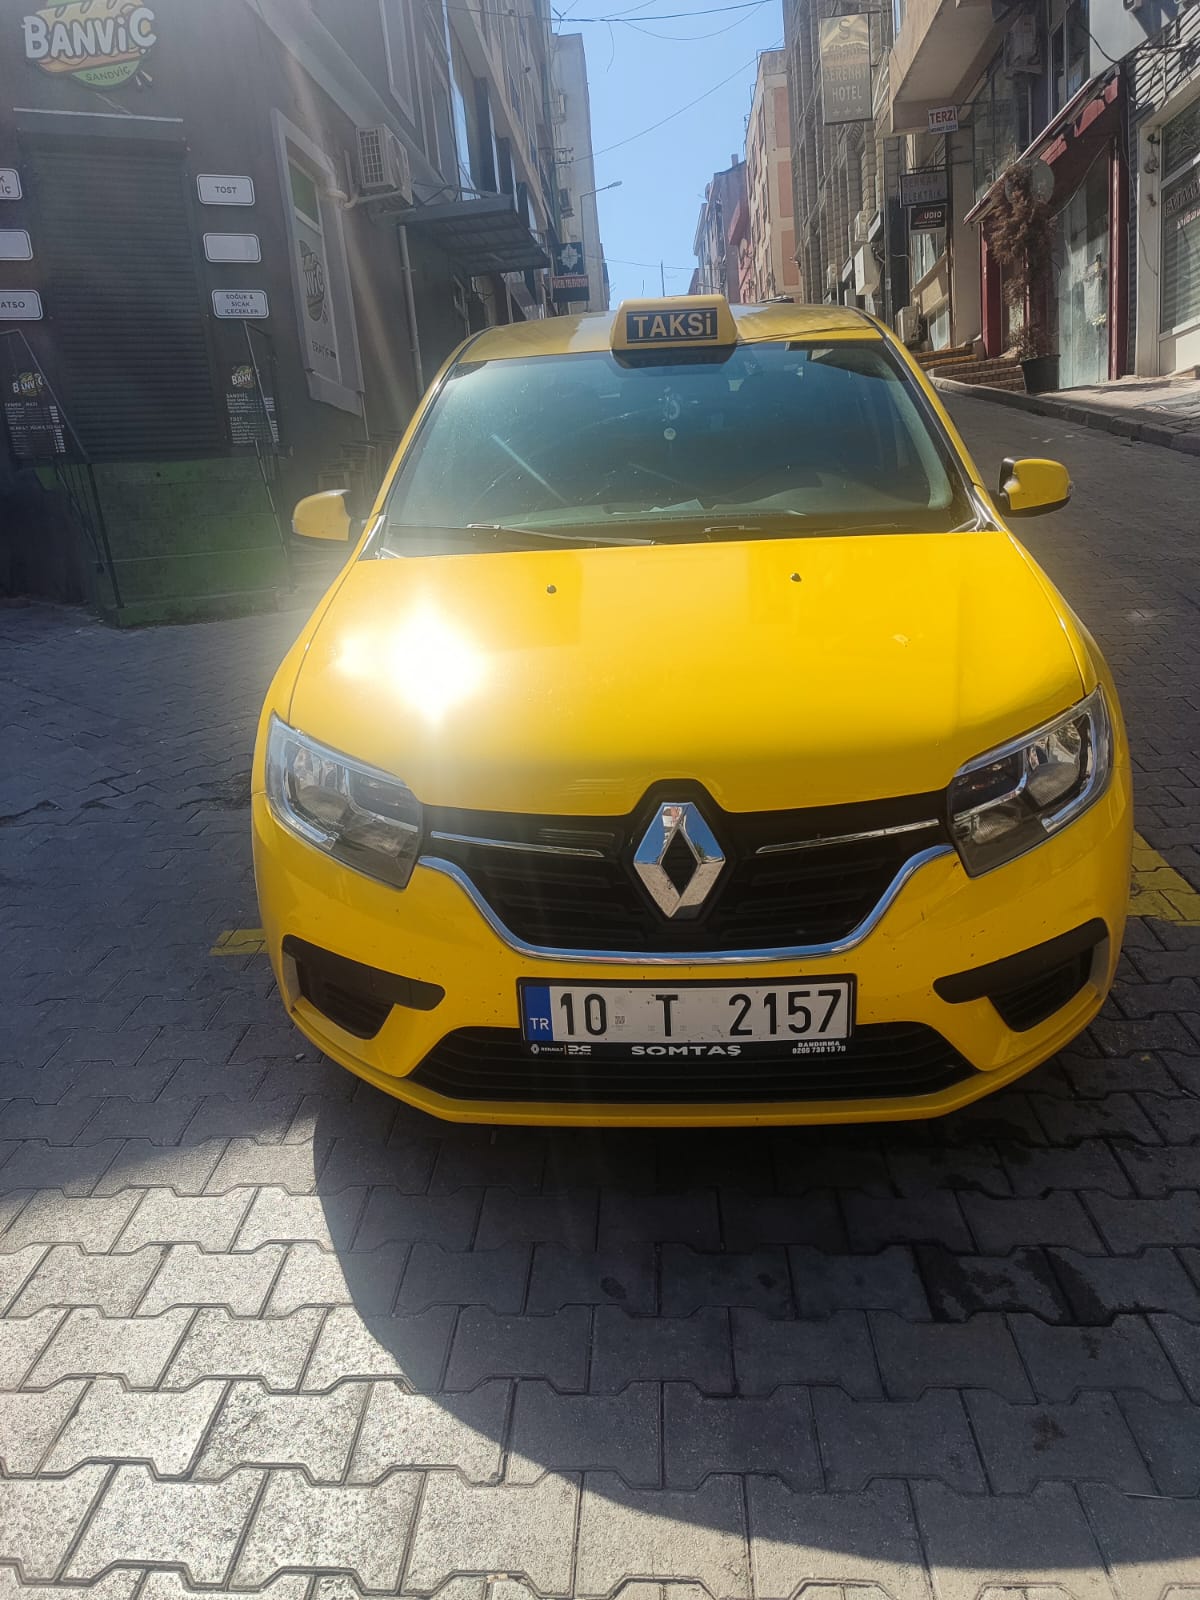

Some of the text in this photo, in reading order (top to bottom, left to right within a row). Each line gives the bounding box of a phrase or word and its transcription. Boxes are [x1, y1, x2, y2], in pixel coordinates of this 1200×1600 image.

[85, 66, 130, 81] SANDVİÇ
[832, 86, 862, 103] HOTEL
[215, 186, 237, 194] TOST
[0, 301, 26, 309] ATSO
[560, 988, 842, 1037] 10 T 2157
[530, 1017, 550, 1031] TR
[631, 1045, 741, 1057] SOMTAŞ
